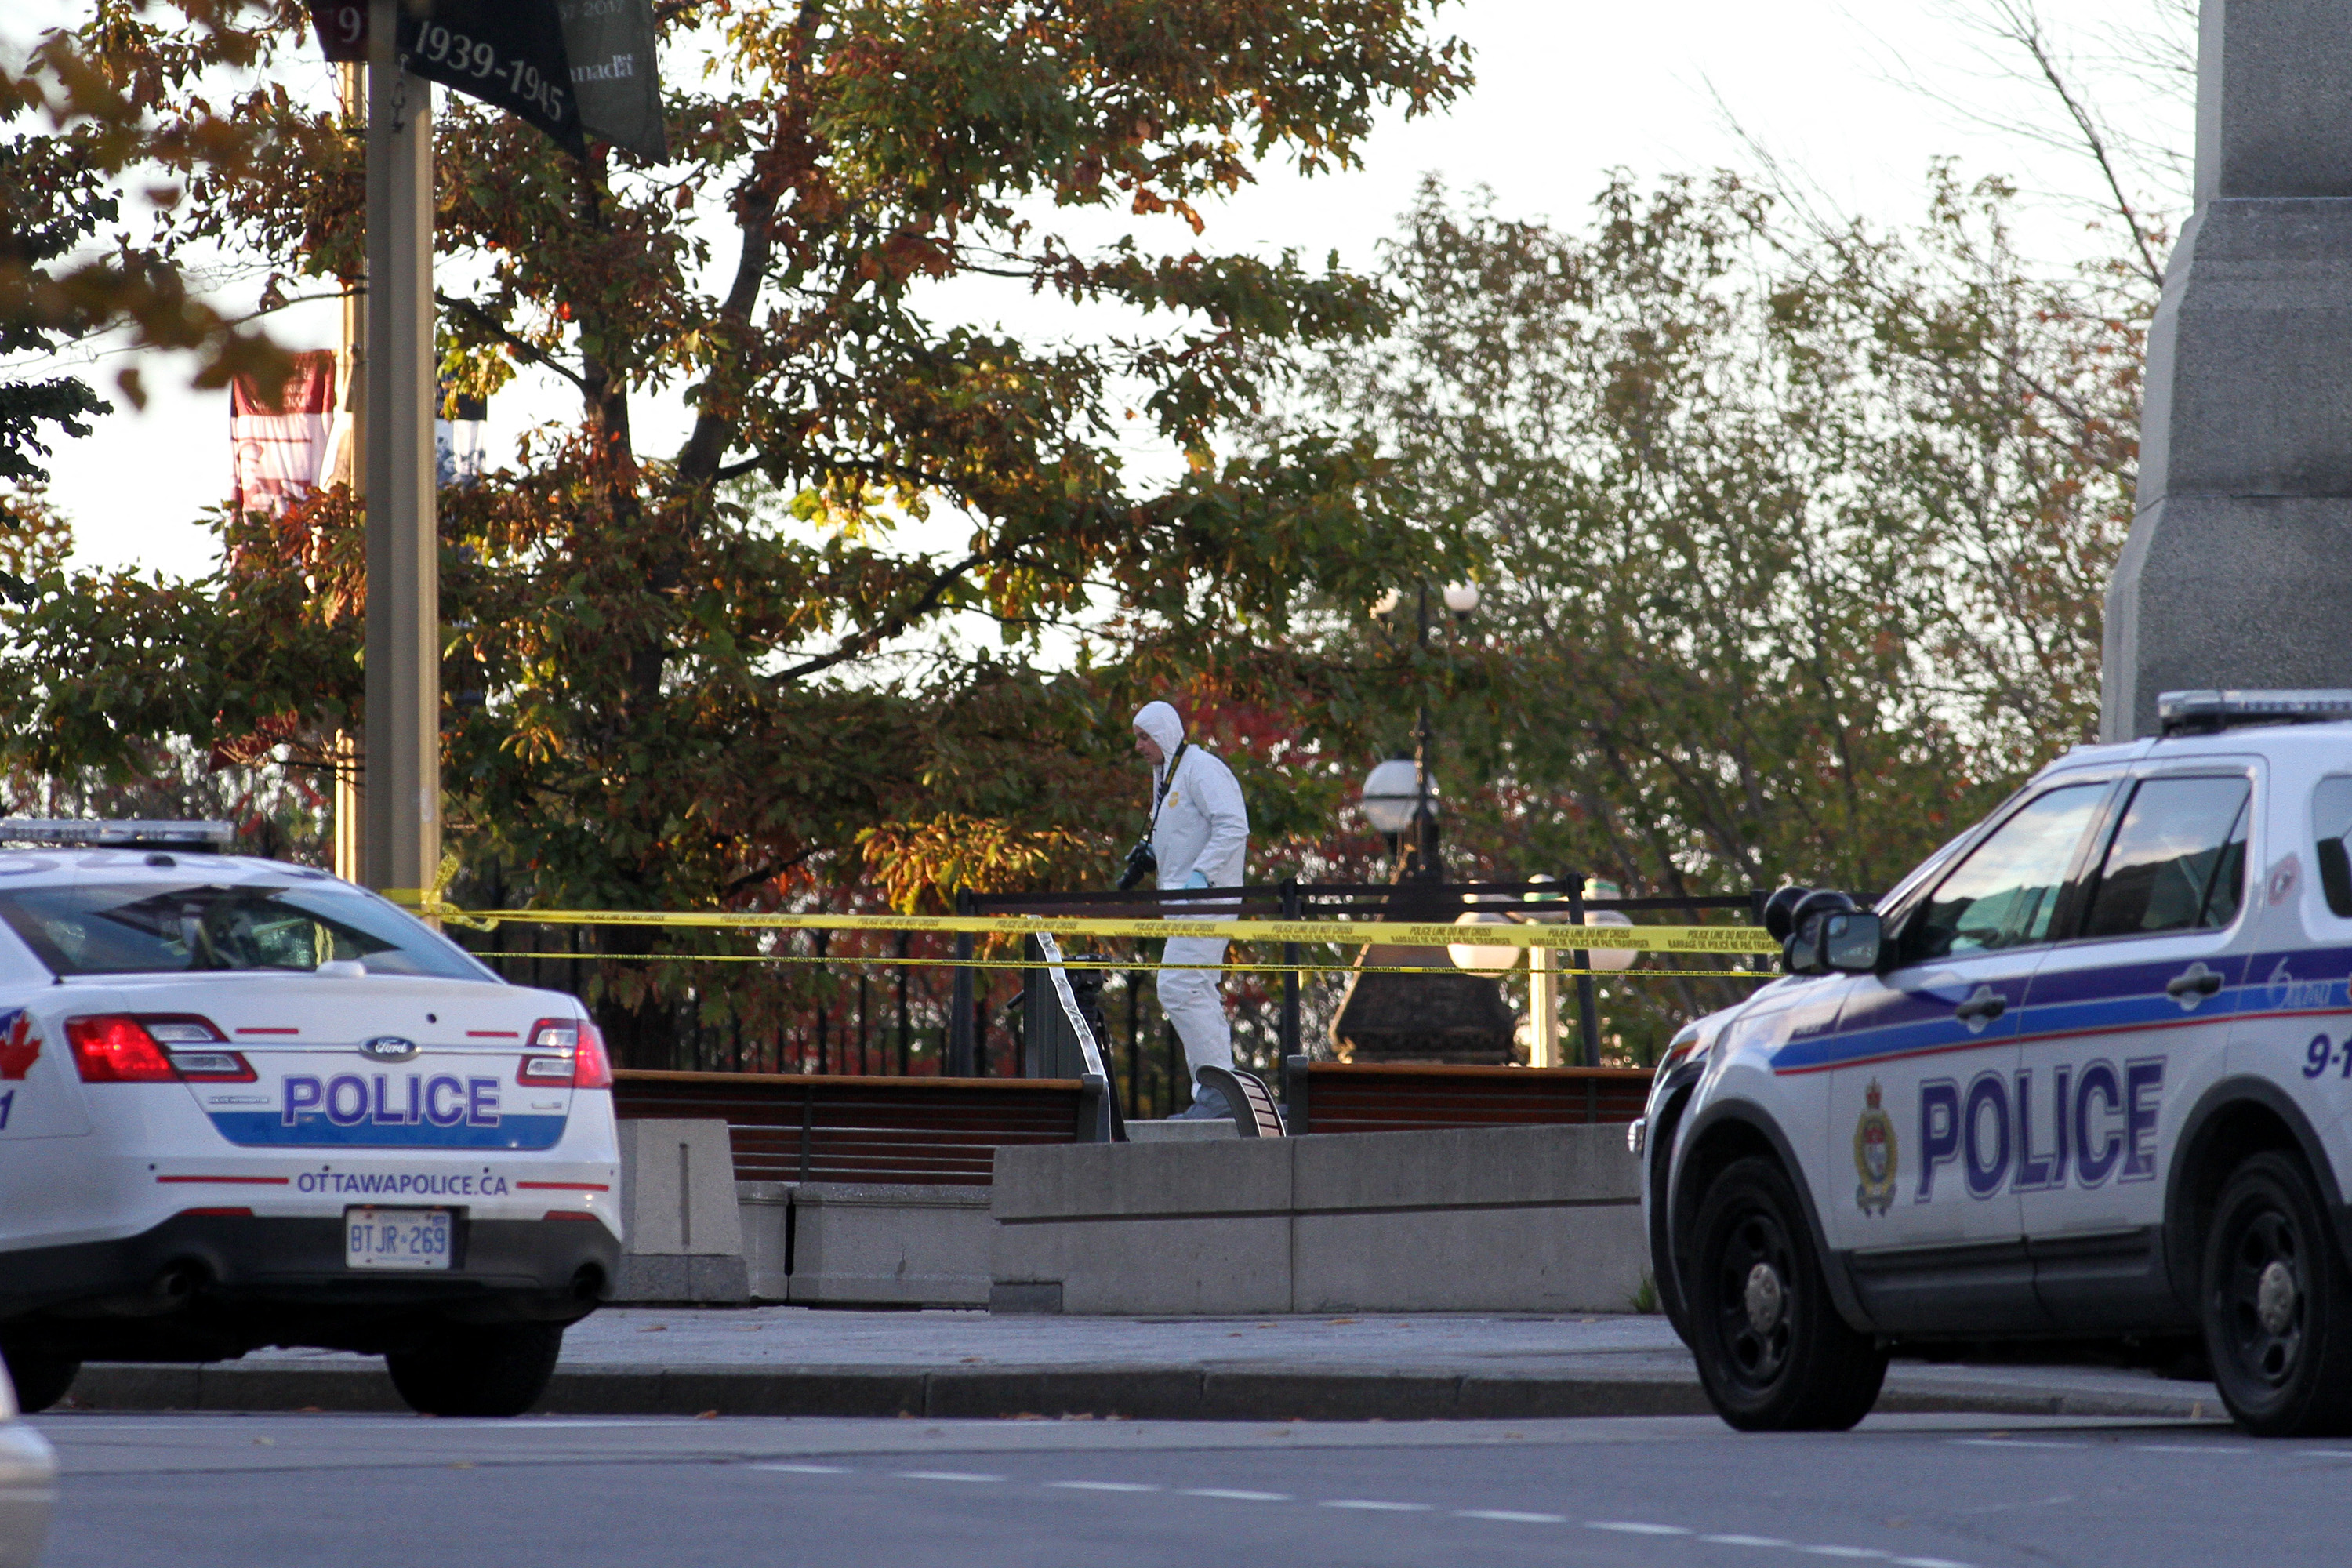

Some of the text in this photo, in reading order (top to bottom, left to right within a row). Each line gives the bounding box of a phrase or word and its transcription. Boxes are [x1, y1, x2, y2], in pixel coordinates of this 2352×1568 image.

[416, 21, 564, 122] 1939-1945
[376, 1039, 406, 1054] Ford
[281, 1073, 501, 1127] POLICE
[1914, 1056, 2166, 1203] POLICE
[297, 1172, 509, 1196] OTTAWAPOLICE.CA
